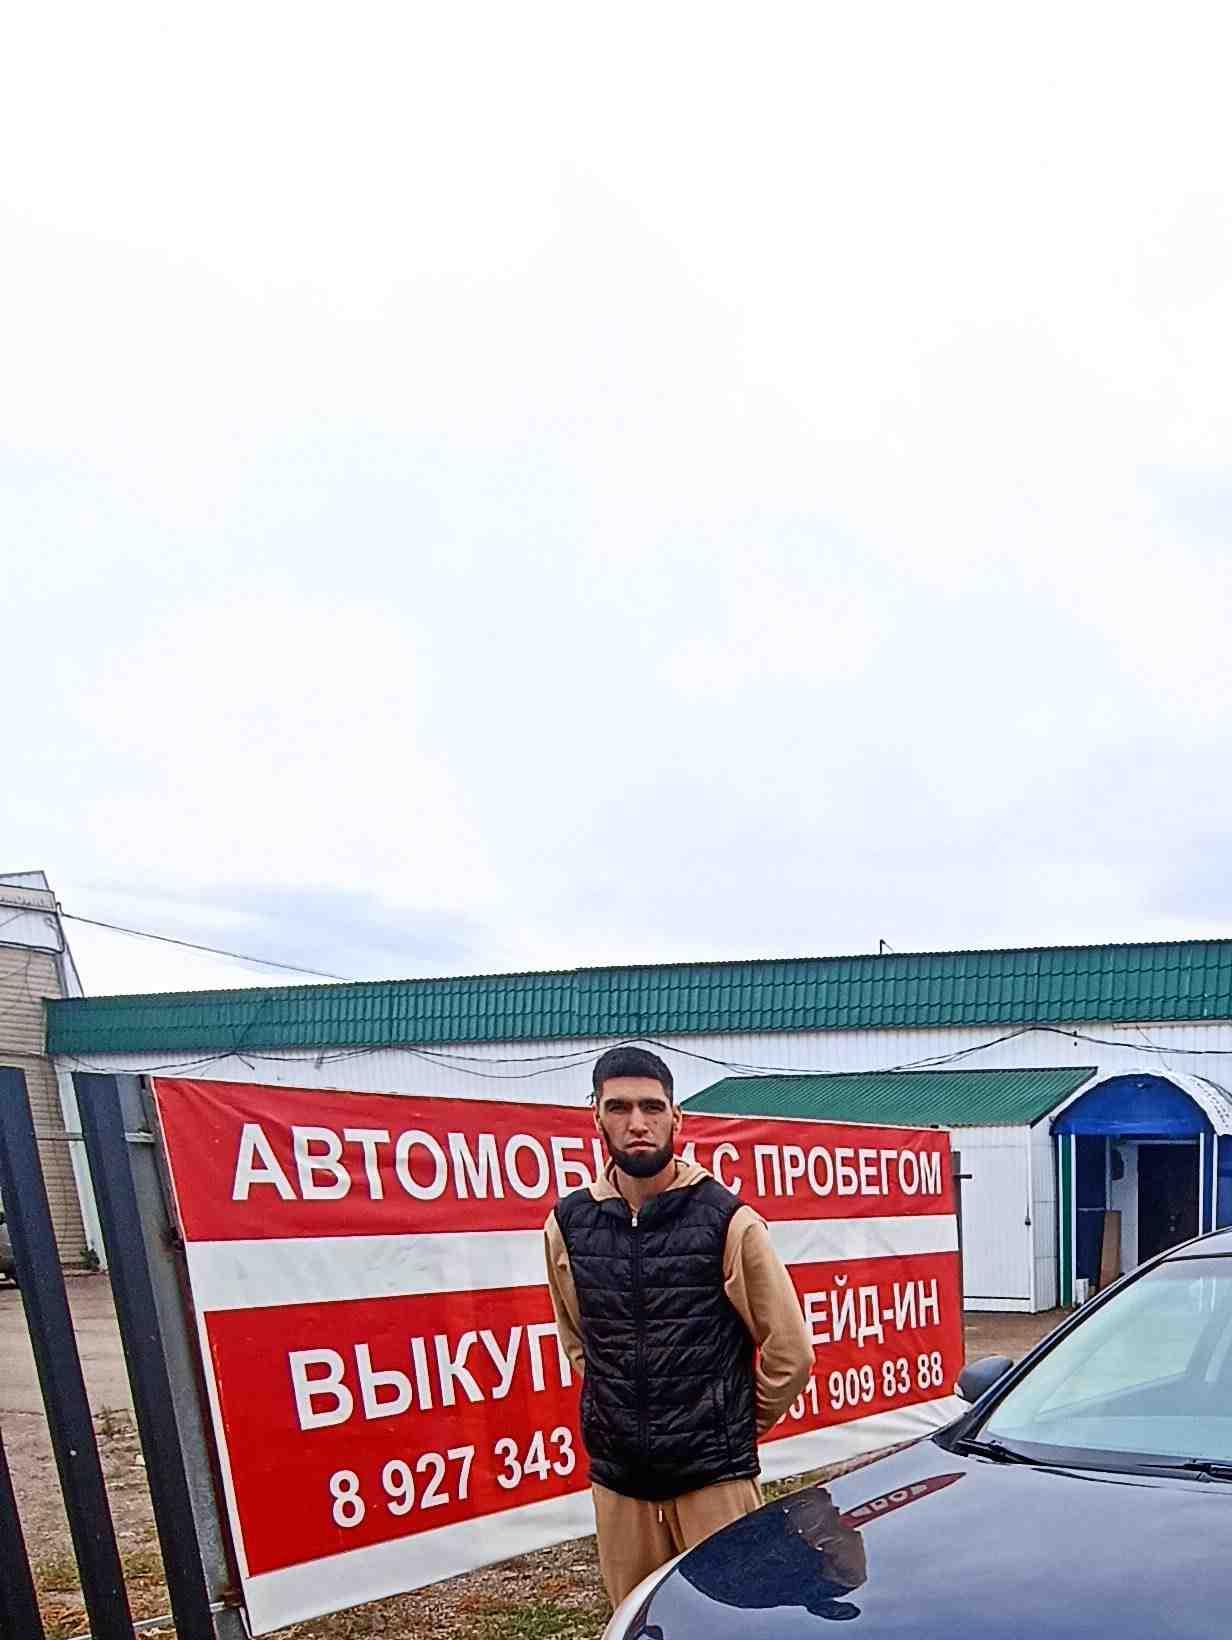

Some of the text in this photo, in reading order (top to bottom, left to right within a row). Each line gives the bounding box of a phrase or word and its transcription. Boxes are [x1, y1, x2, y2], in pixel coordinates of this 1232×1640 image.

[232, 1122, 942, 1201] АВТОМОБ С ПРОБЕГОМ
[288, 1274, 940, 1430] ВЫКУП ЕЙД-ИН
[829, 1365, 874, 1410] 909
[883, 1358, 910, 1397] 83
[918, 1351, 943, 1389] 88
[330, 1426, 576, 1527] 8 927 343
